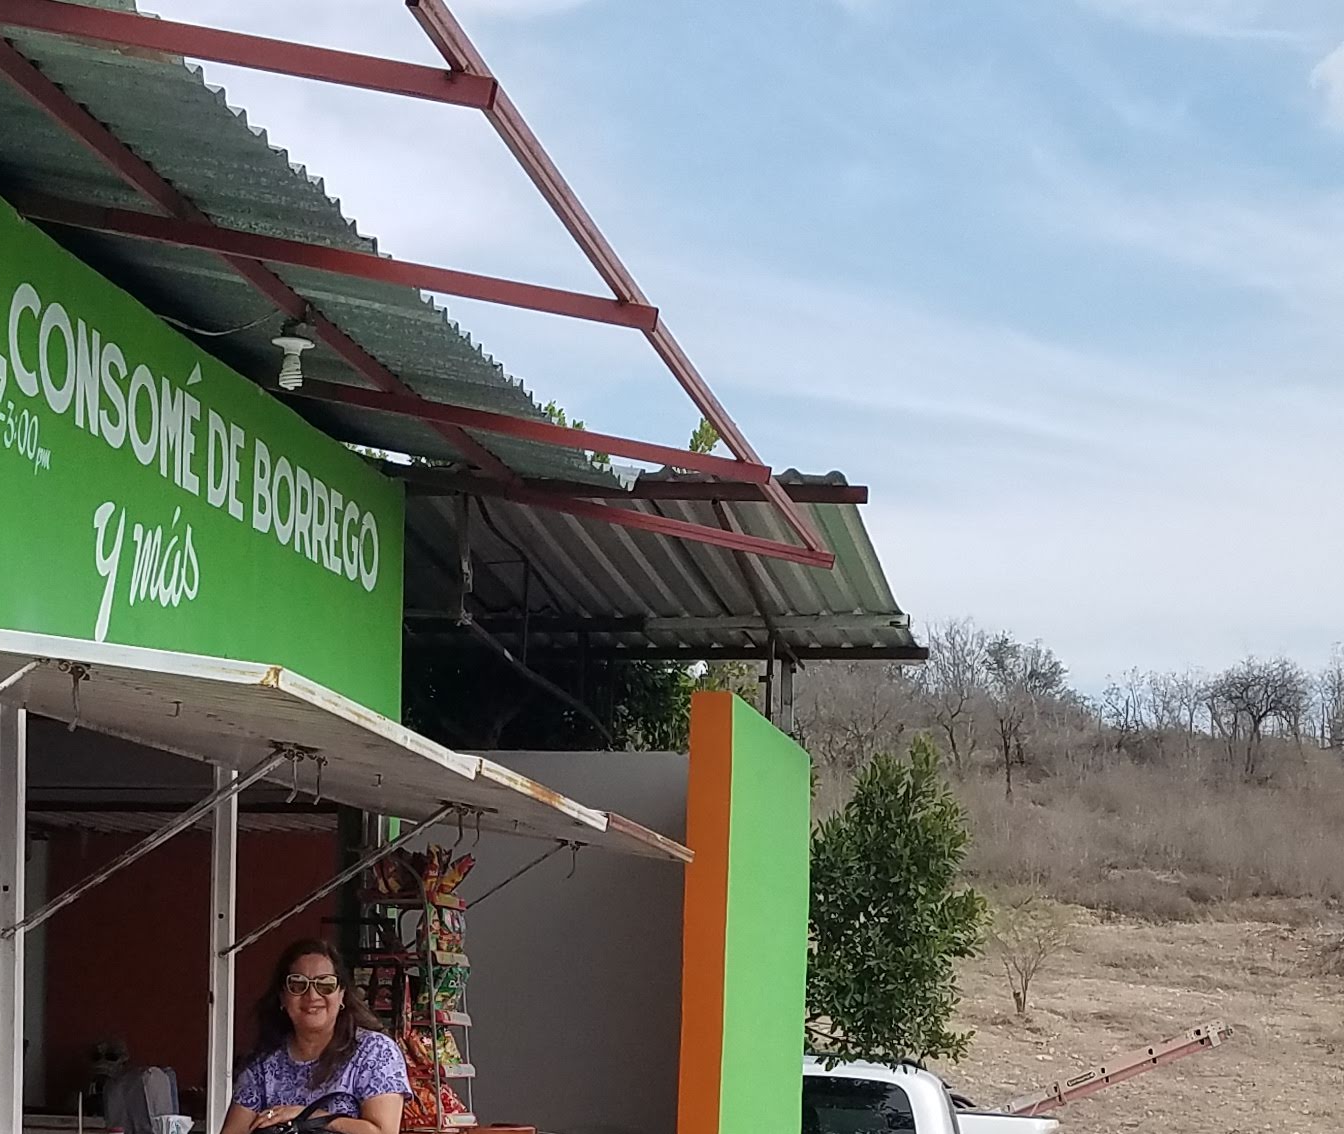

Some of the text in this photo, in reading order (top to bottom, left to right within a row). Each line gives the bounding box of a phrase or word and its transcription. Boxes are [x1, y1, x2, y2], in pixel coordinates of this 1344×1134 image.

[8, 283, 202, 497] CONSOMÉ
[207, 408, 245, 522] DE
[252, 438, 379, 593] BORREGO
[128, 506, 200, 608] más
